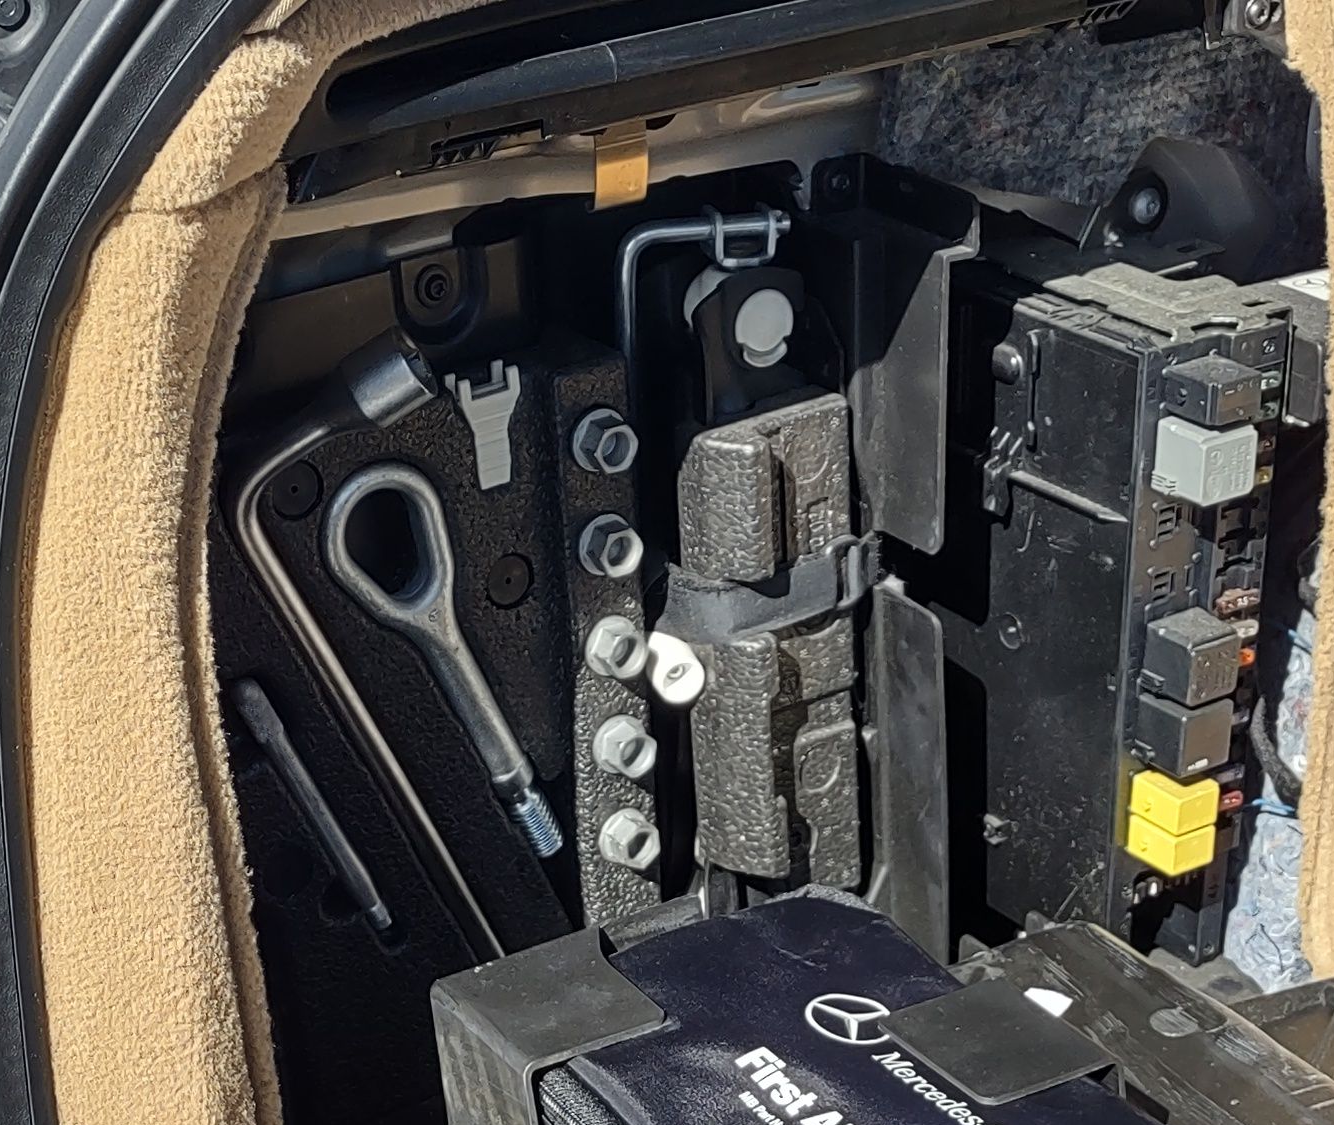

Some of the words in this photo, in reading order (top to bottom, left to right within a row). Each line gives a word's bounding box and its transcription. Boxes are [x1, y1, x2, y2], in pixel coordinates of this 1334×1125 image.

[734, 1046, 818, 1118] First
[738, 1090, 760, 1109] MB
[752, 1104, 776, 1123] Part
